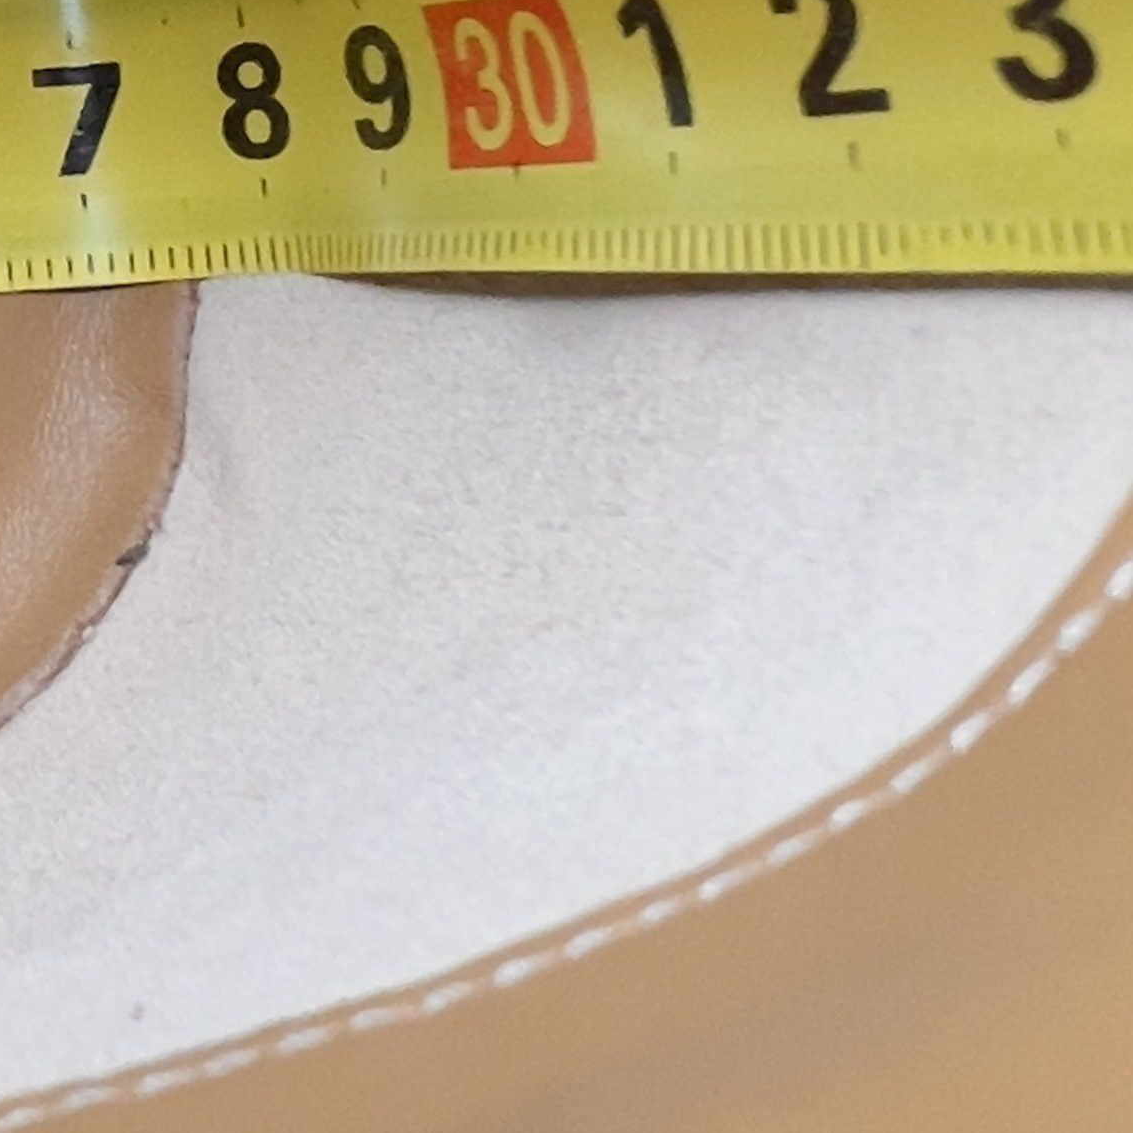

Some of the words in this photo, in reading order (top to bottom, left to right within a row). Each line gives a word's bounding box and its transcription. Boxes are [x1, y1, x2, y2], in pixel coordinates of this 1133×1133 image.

[31, 61, 122, 177] 7
[216, 41, 291, 161] 8
[343, 24, 412, 151] 9
[454, 9, 572, 151] 30
